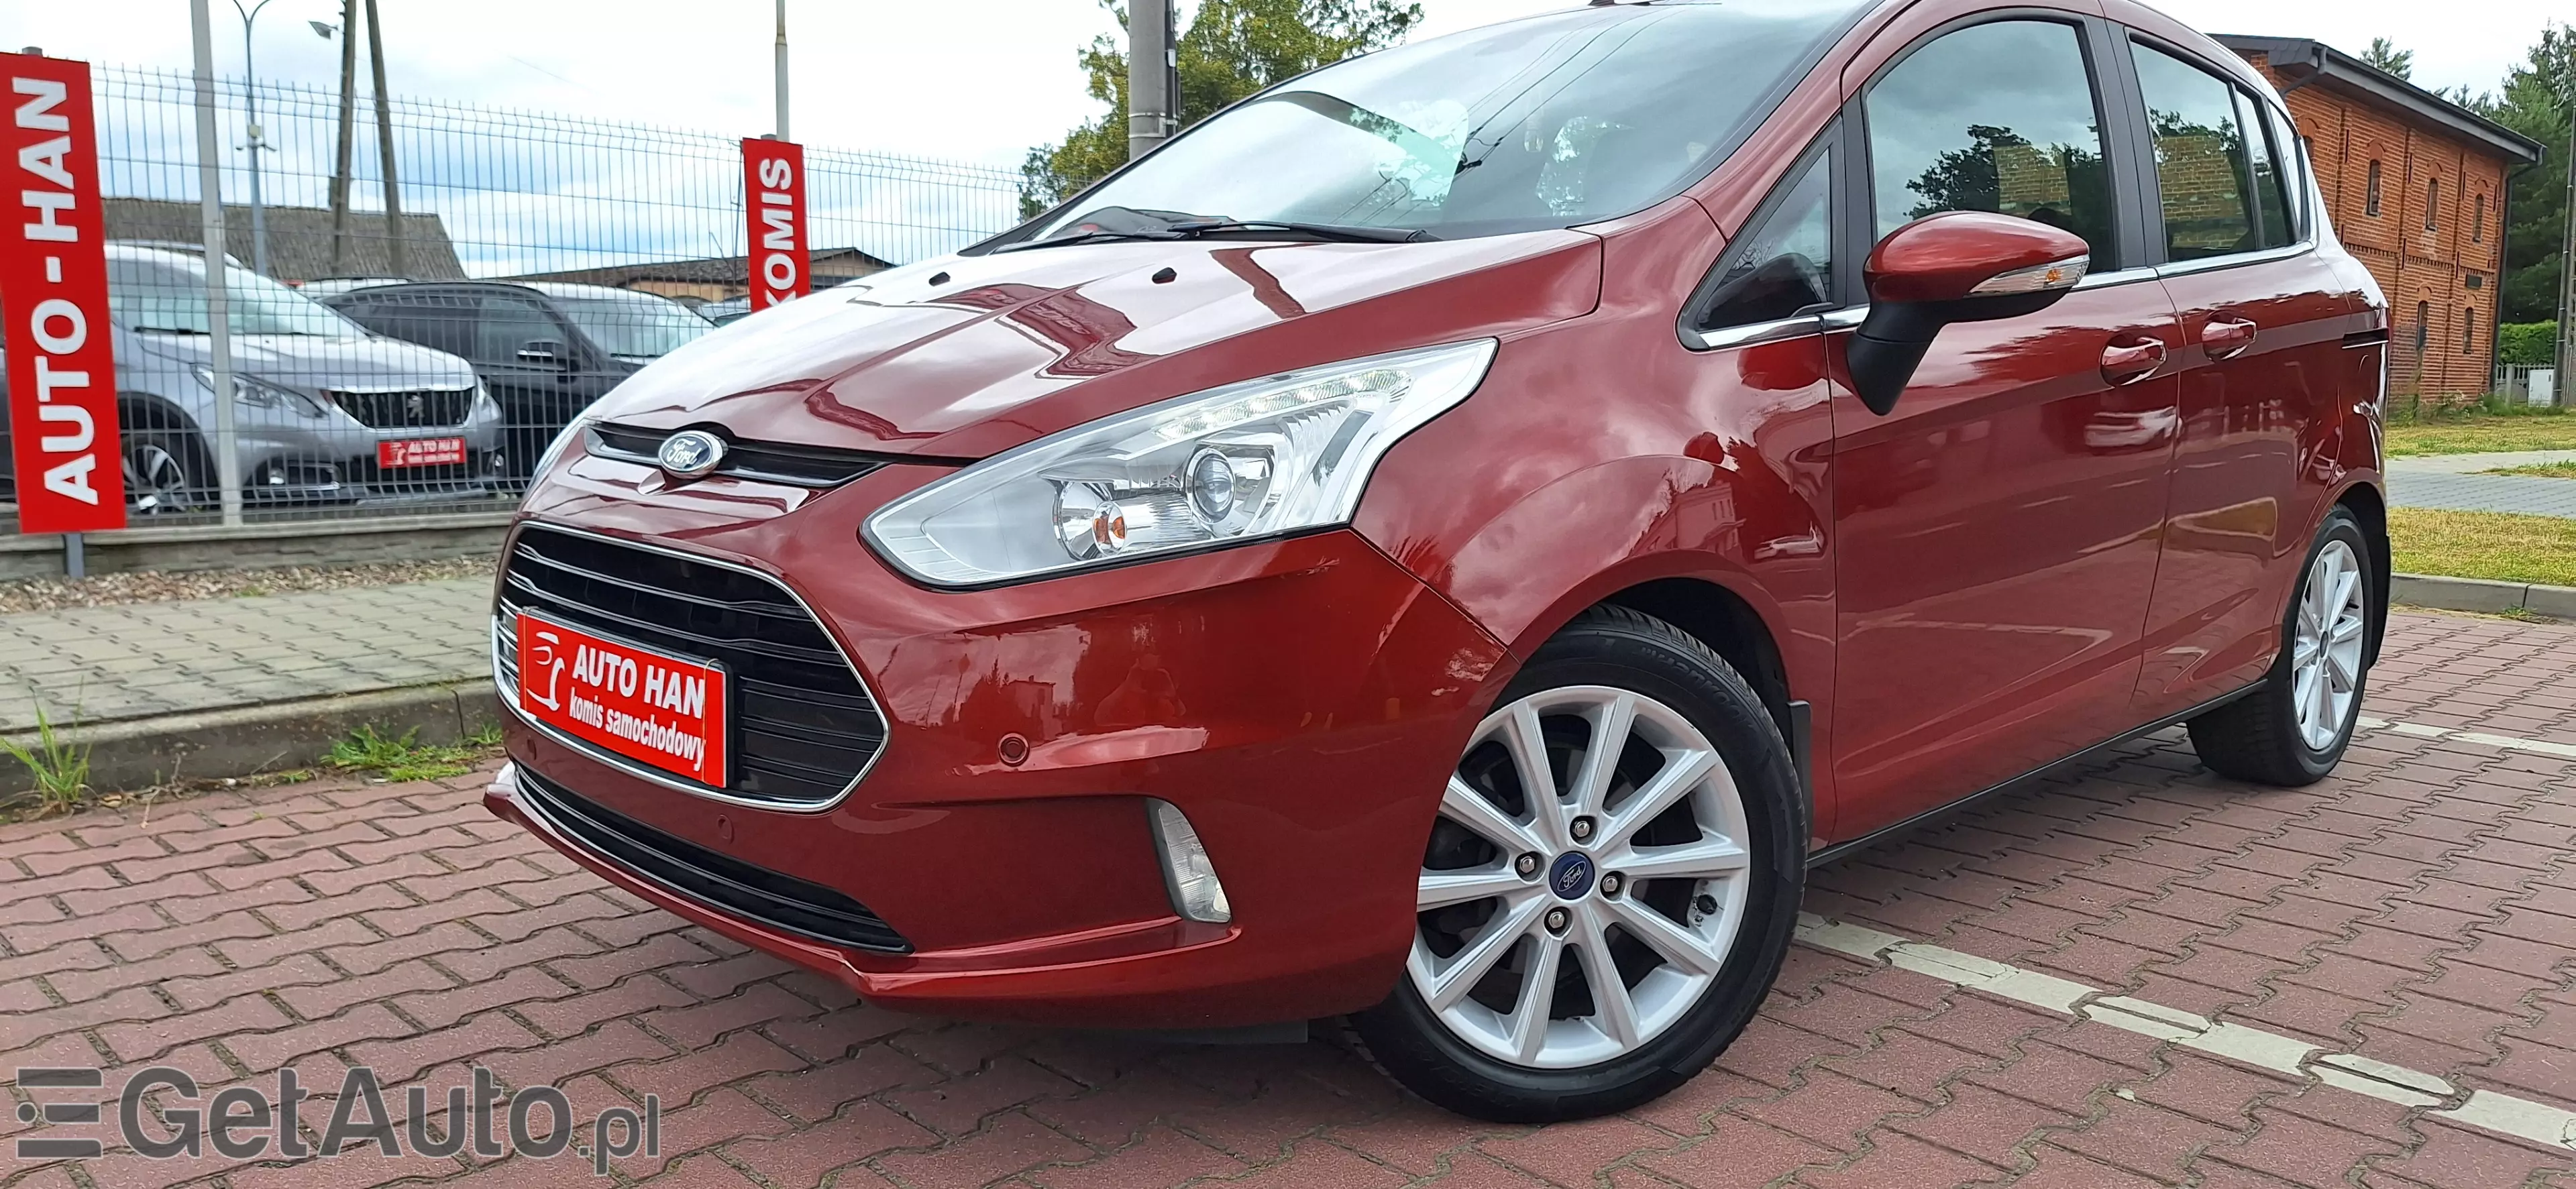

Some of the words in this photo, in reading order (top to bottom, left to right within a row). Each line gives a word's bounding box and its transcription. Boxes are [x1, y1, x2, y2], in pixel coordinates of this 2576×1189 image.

[12, 76, 79, 243] HAN
[31, 298, 99, 506] AUTO
[666, 438, 702, 465] Ford
[572, 644, 637, 697] AUTO
[644, 665, 705, 719] HAN
[569, 686, 604, 729] komis
[605, 708, 706, 772] samochodowy
[1563, 865, 1582, 888] Ford
